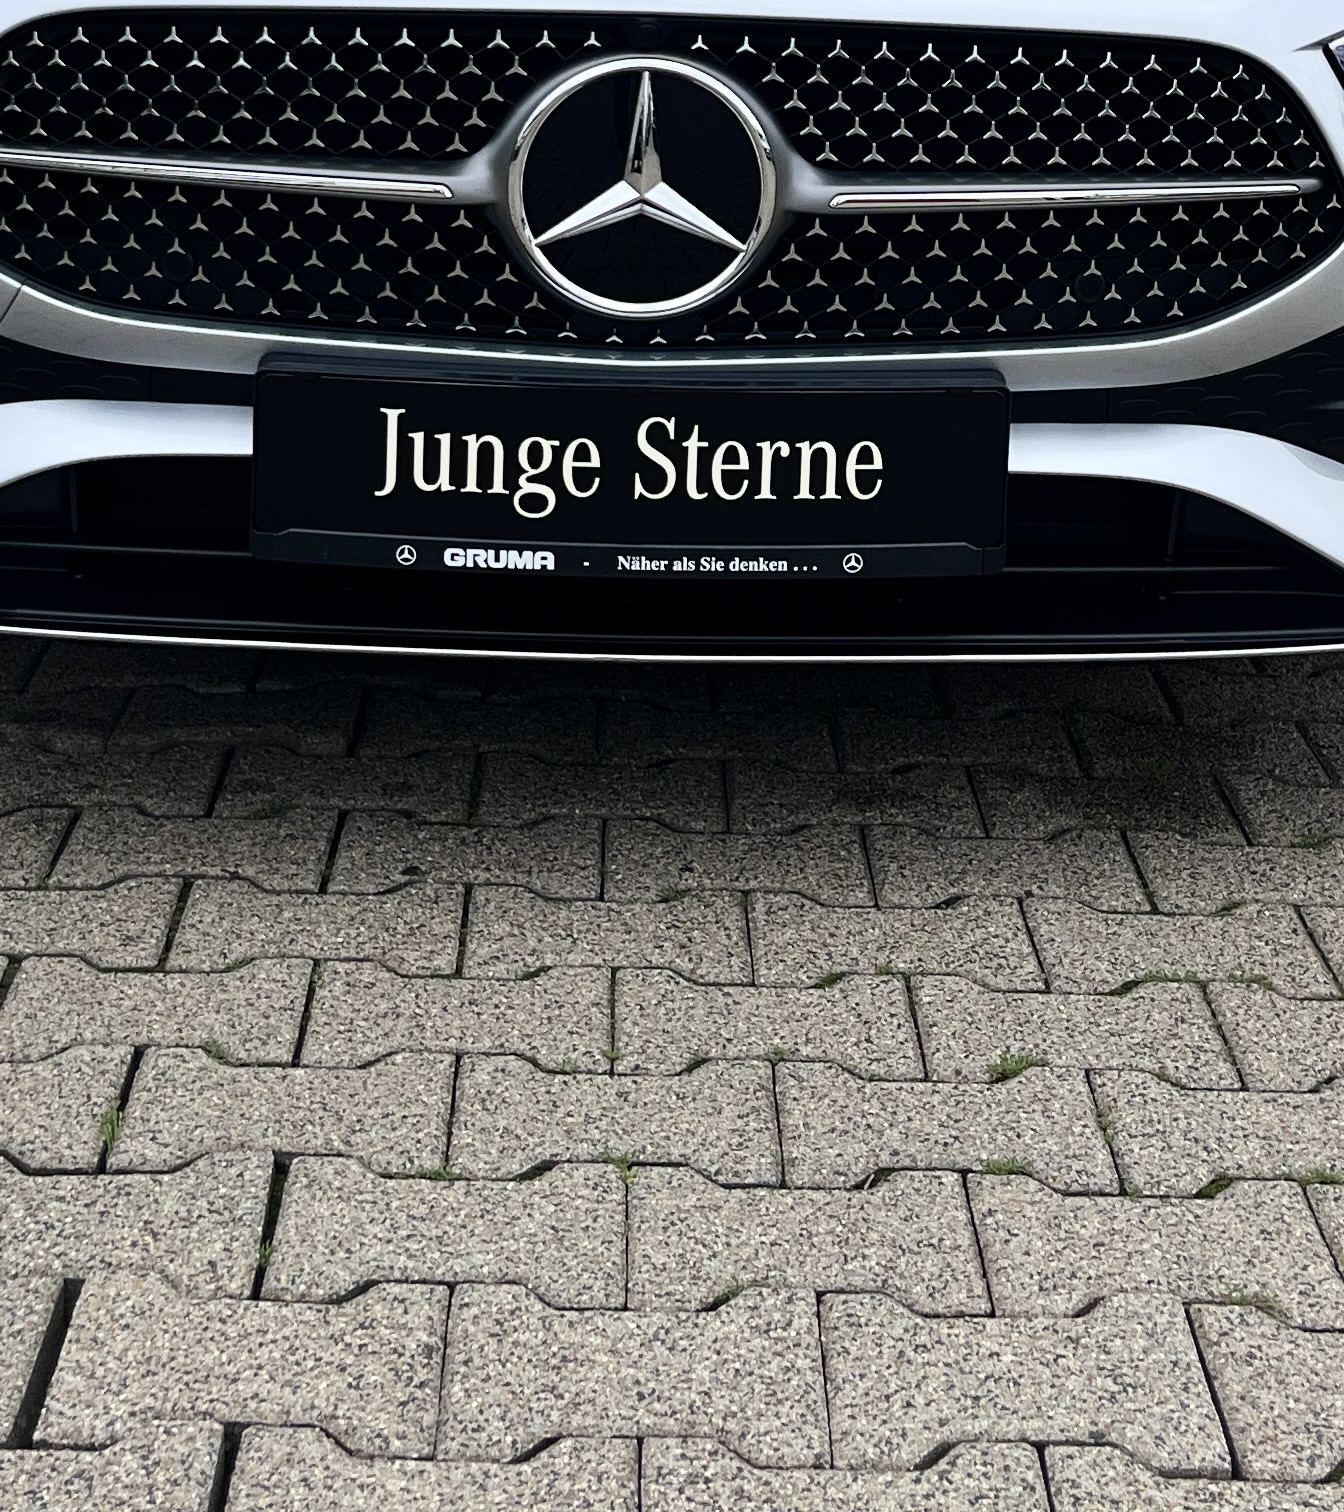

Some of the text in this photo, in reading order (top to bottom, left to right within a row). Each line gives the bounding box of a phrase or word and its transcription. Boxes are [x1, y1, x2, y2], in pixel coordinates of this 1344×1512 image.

[374, 407, 884, 519] Junge Sterne
[443, 547, 555, 571] GRUMA
[617, 555, 669, 572] Näher
[672, 556, 696, 572] als
[699, 556, 725, 572] Sie
[728, 556, 788, 572] denken
